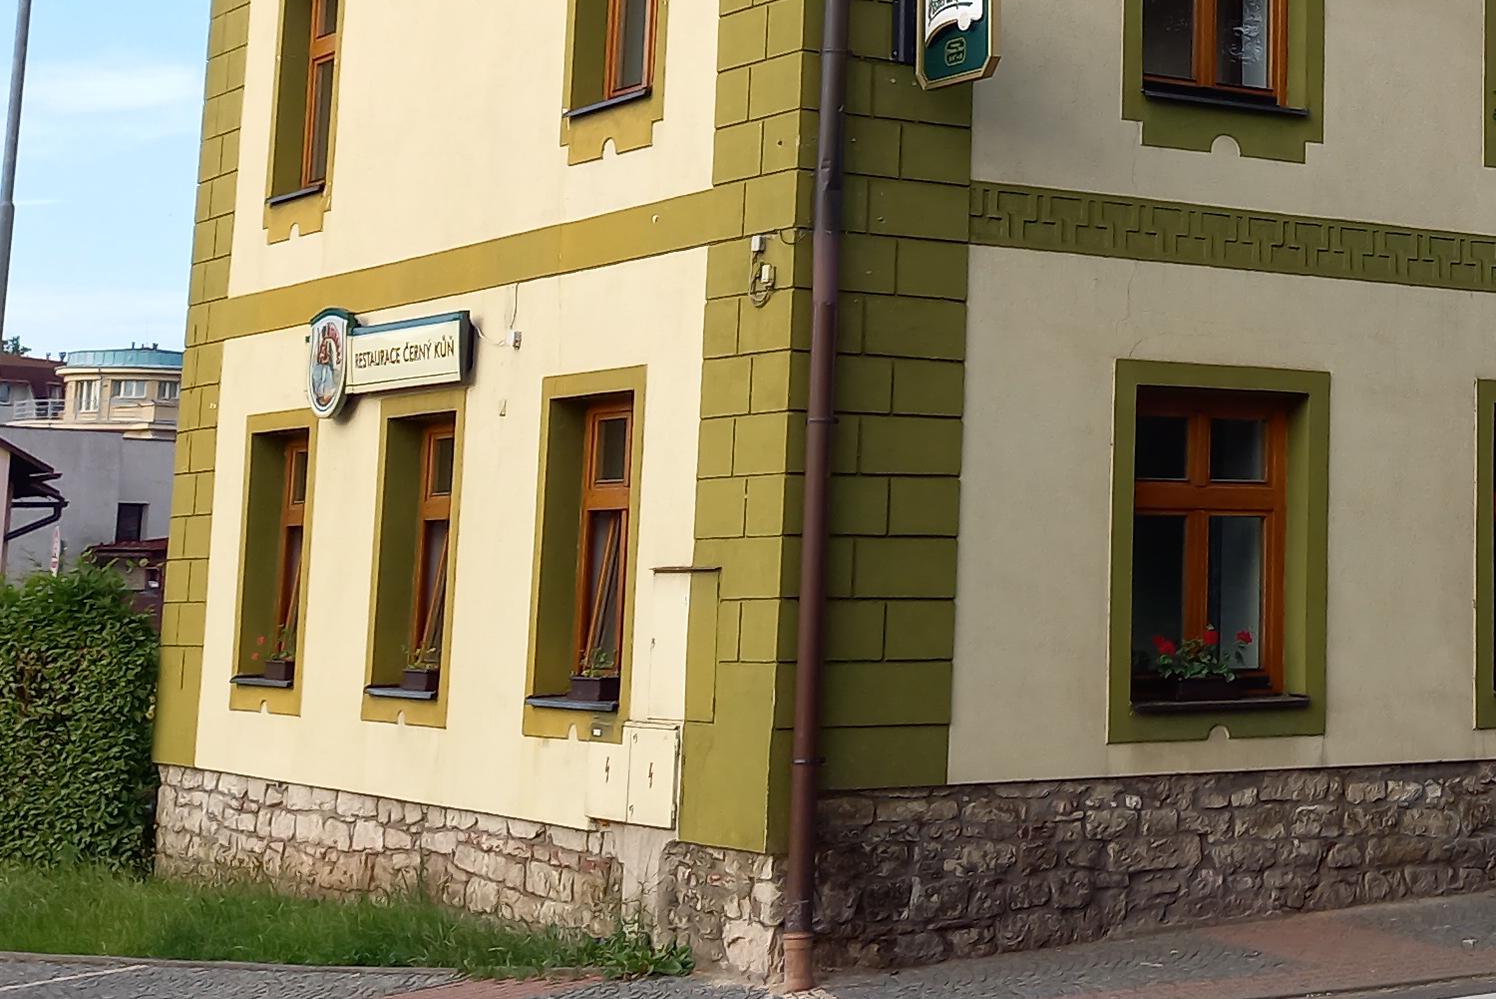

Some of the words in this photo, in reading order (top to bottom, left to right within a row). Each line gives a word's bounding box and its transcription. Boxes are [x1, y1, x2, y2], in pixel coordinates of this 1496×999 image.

[354, 347, 400, 368] RESTAURACE
[403, 341, 431, 362] ČERNÝ
[434, 334, 455, 359] KŮŇ
